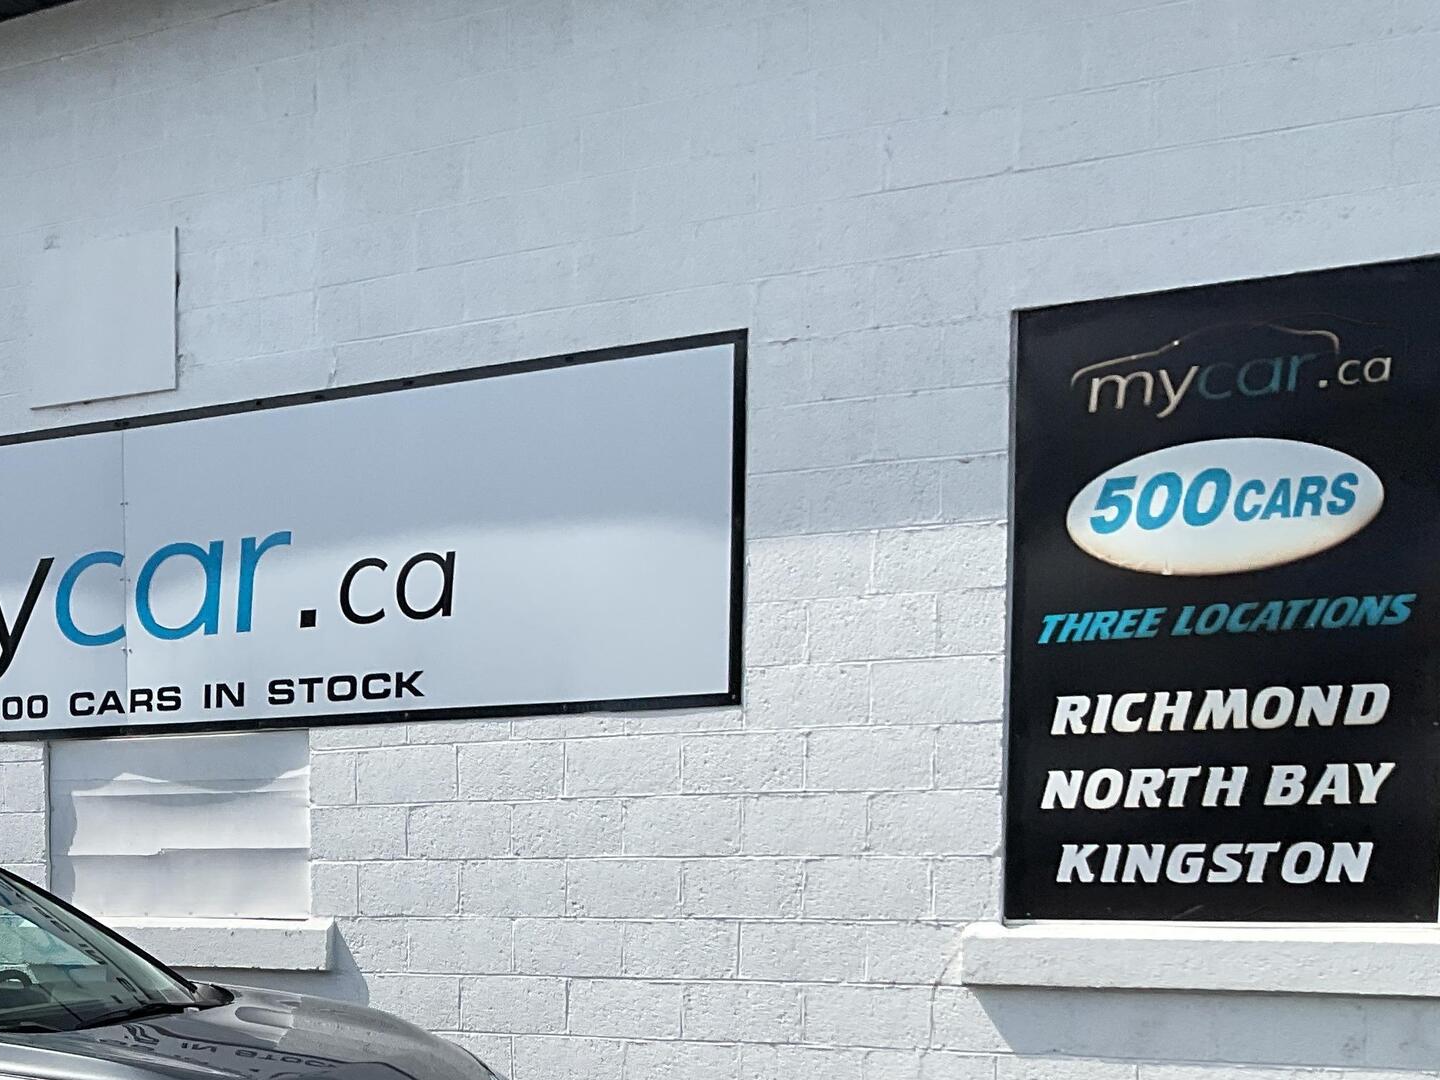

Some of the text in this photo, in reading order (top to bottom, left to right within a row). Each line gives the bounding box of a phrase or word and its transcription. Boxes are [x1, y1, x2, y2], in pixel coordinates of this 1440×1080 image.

[1088, 354, 1392, 418] mycar.ca
[1037, 593, 1417, 645] THREE LOCATIONS
[68, 686, 182, 716] CARS
[203, 681, 246, 710] IN
[267, 670, 425, 703] STOCK
[1050, 683, 1391, 736] RICHMOND
[1040, 762, 1396, 811] NORTH BAY
[1056, 841, 1374, 884] KINGSTON
